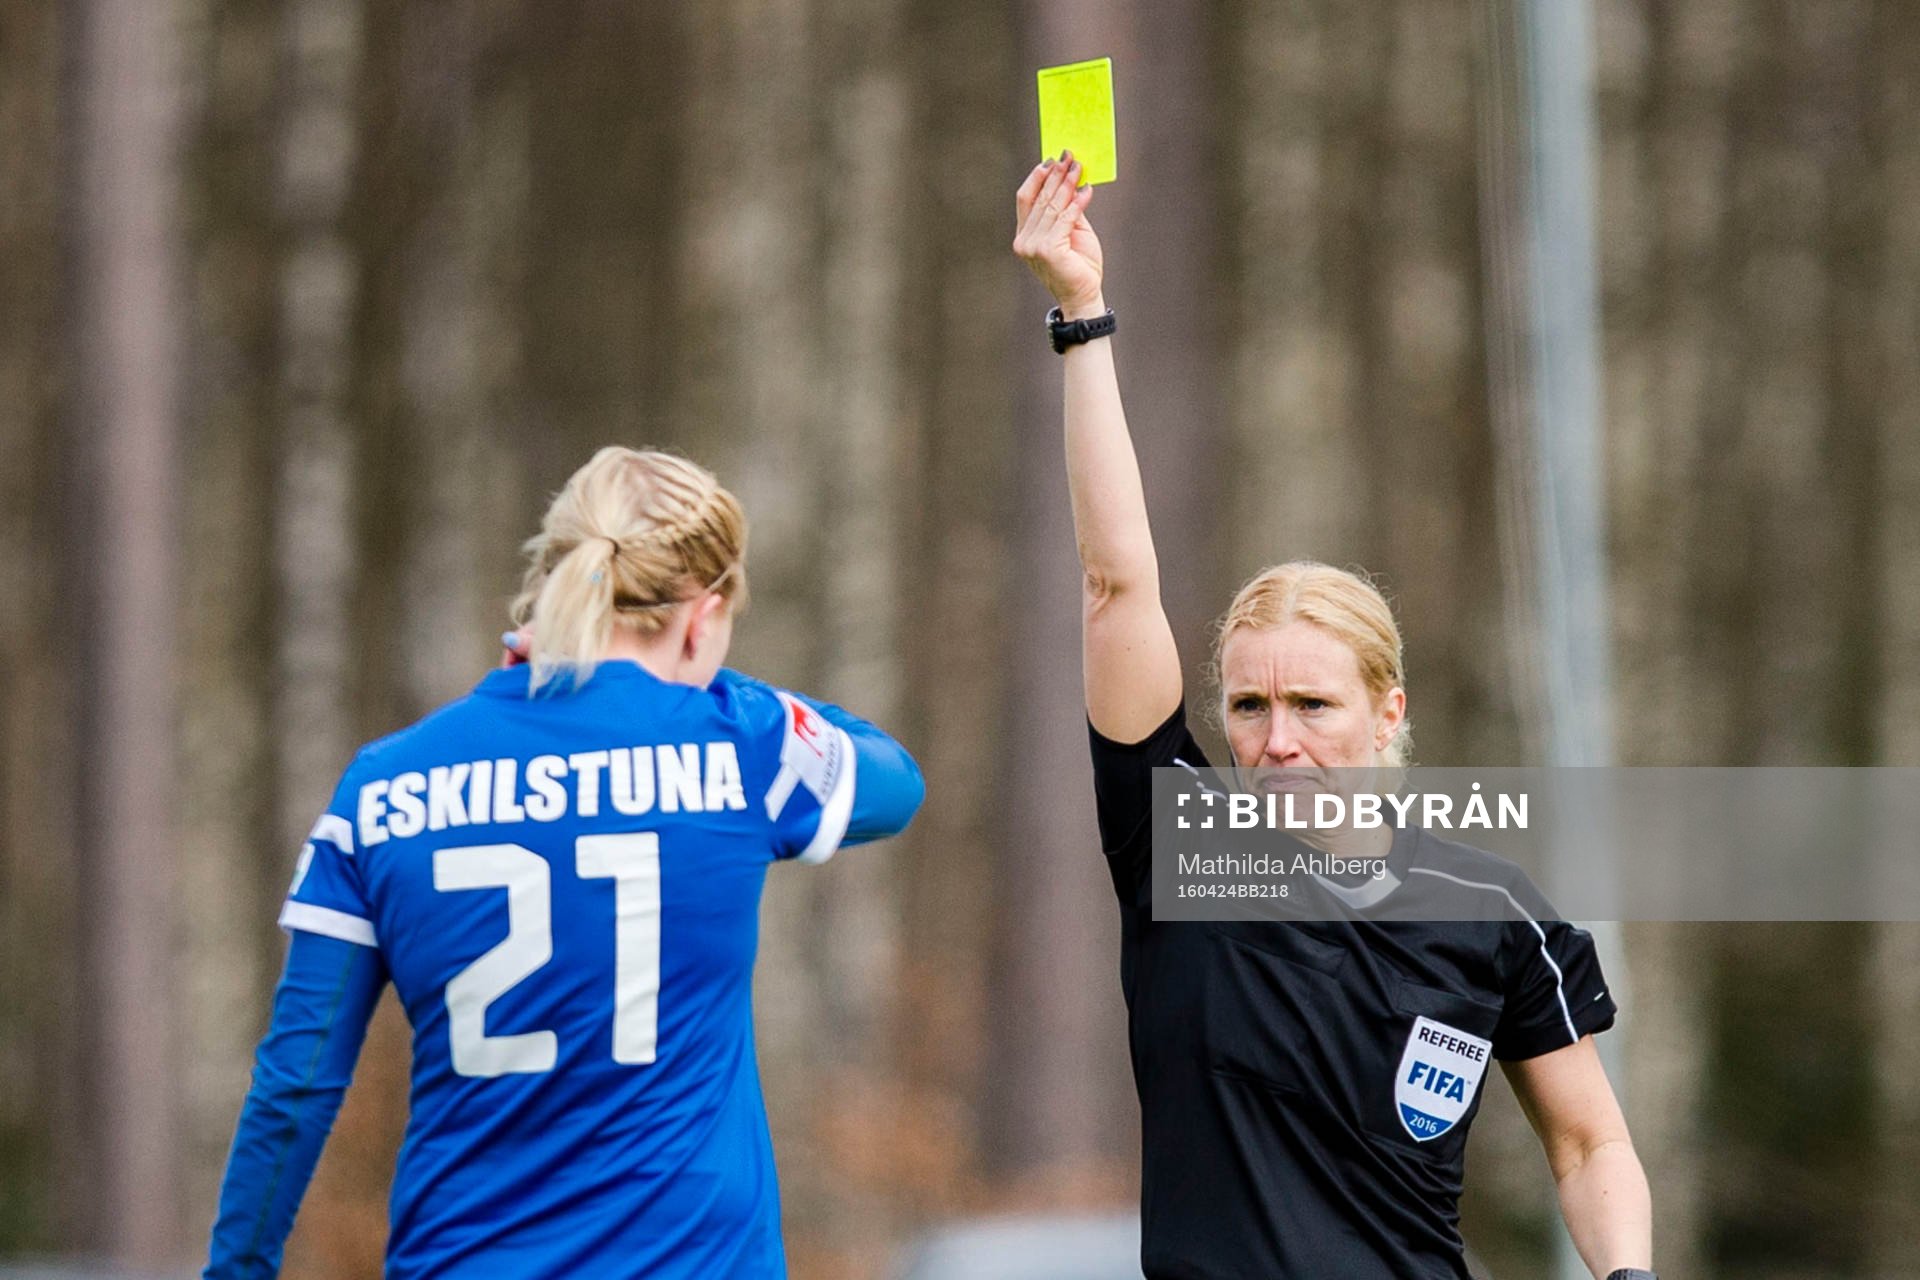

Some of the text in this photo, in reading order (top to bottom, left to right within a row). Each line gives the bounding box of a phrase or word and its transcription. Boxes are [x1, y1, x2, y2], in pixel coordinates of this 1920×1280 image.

[357, 741, 748, 847] ESKILSTUNA
[433, 832, 661, 1078] 21
[1418, 1026, 1485, 1062] REFEREE
[1407, 1061, 1465, 1103] FIFA
[1409, 1114, 1438, 1133] 2016
